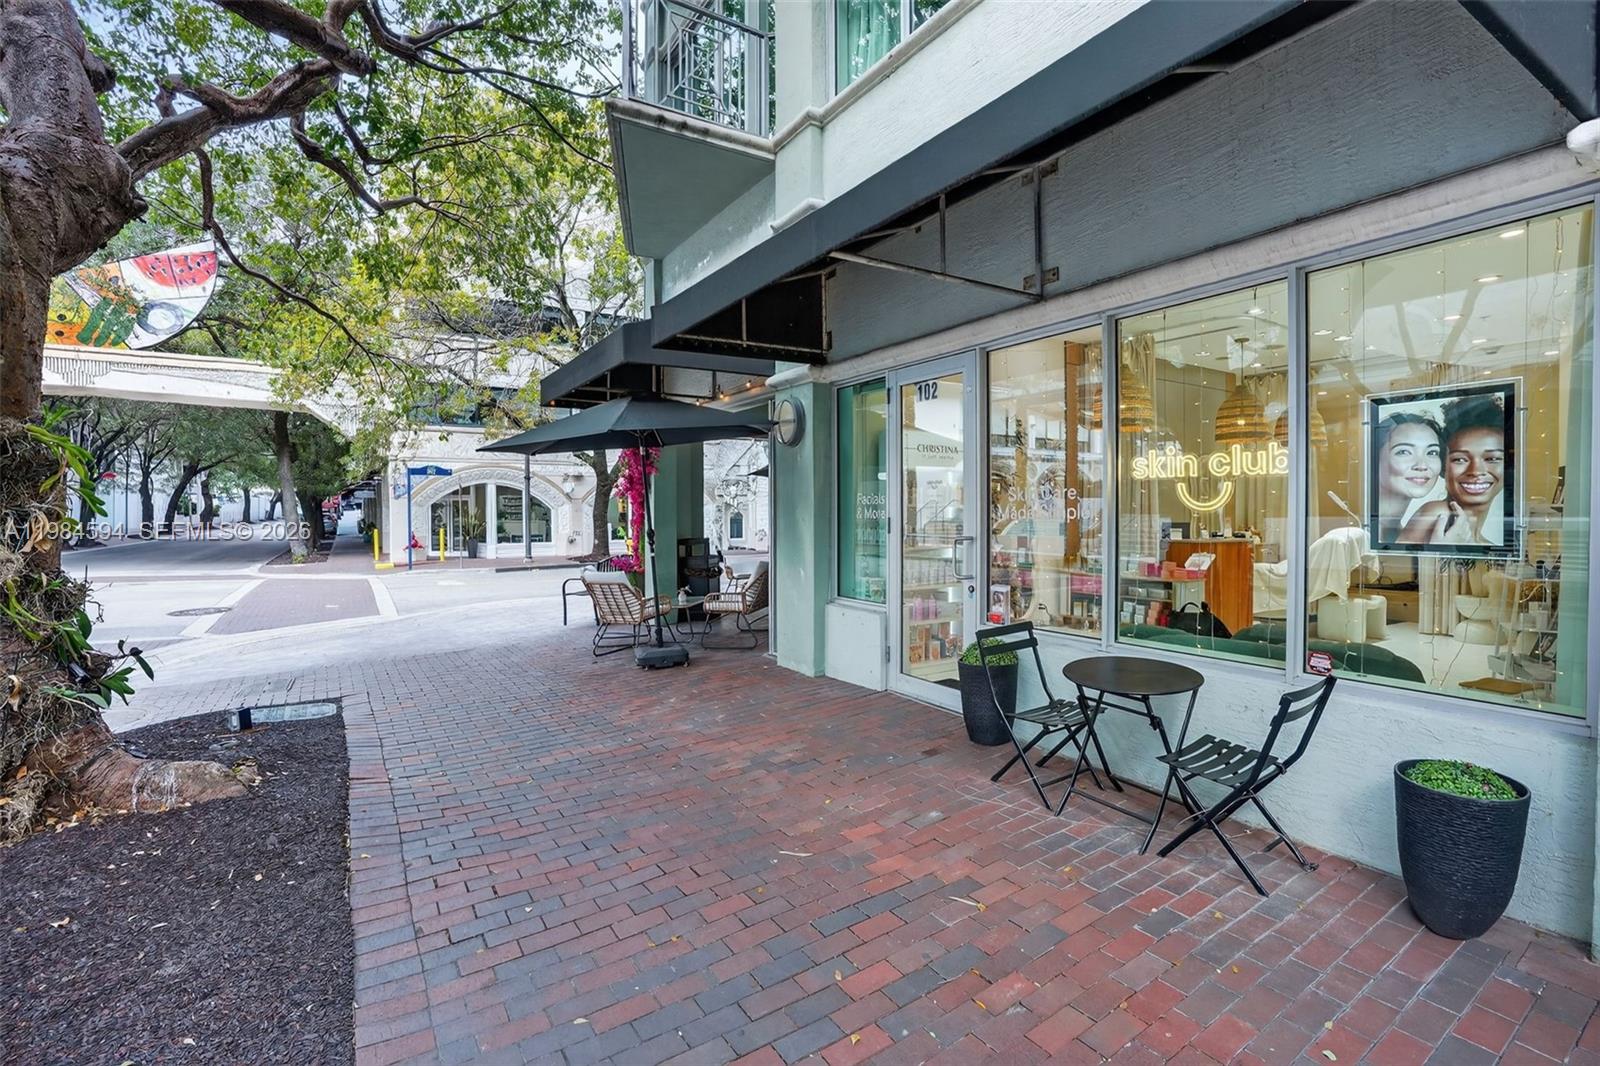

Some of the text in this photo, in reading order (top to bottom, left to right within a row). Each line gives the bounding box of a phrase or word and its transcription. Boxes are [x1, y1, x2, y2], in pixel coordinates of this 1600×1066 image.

[917, 382, 938, 402] 102
[916, 443, 959, 455] CHRISTINA
[1132, 442, 1289, 479] skin club
